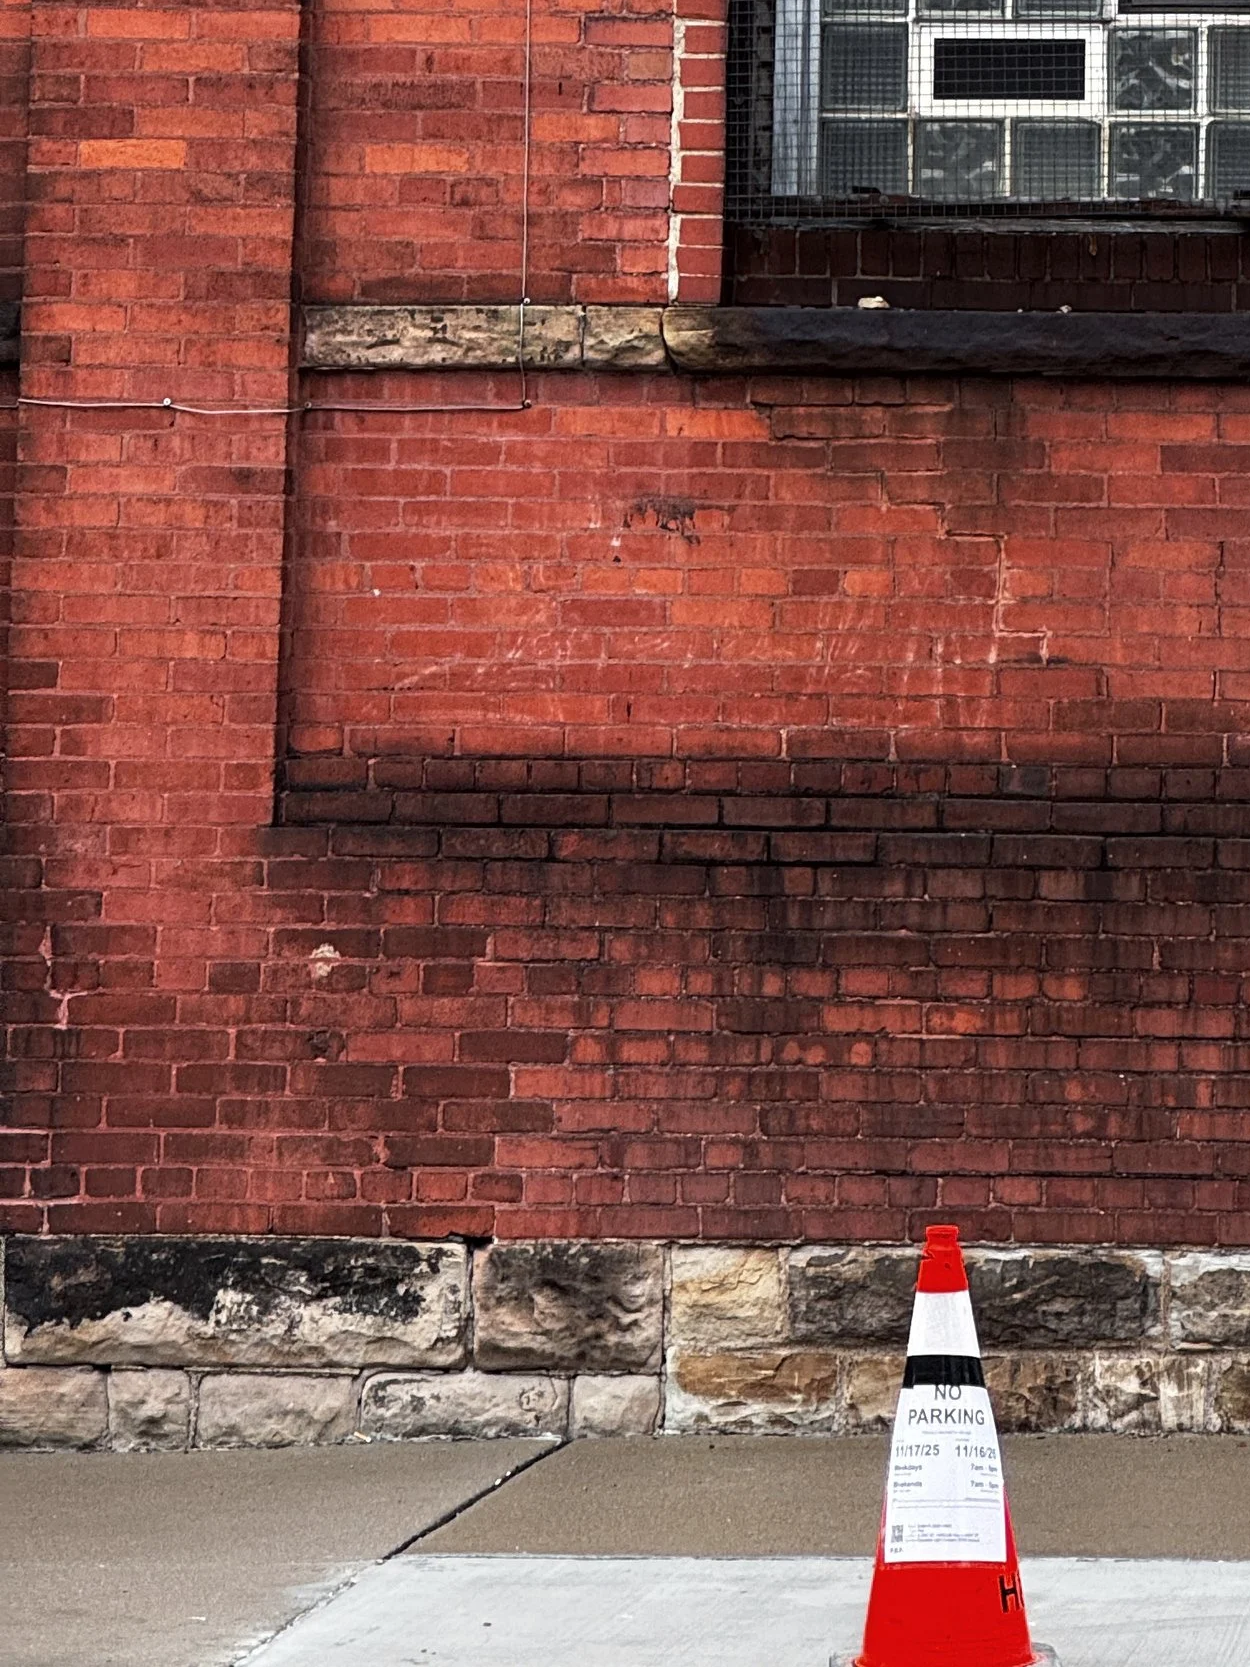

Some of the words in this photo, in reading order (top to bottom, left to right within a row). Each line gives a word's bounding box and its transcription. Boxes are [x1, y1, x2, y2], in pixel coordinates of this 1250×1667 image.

[934, 1384, 962, 1400] NO
[908, 1408, 985, 1426] PARKING
[895, 1444, 940, 1458] 11/17/25
